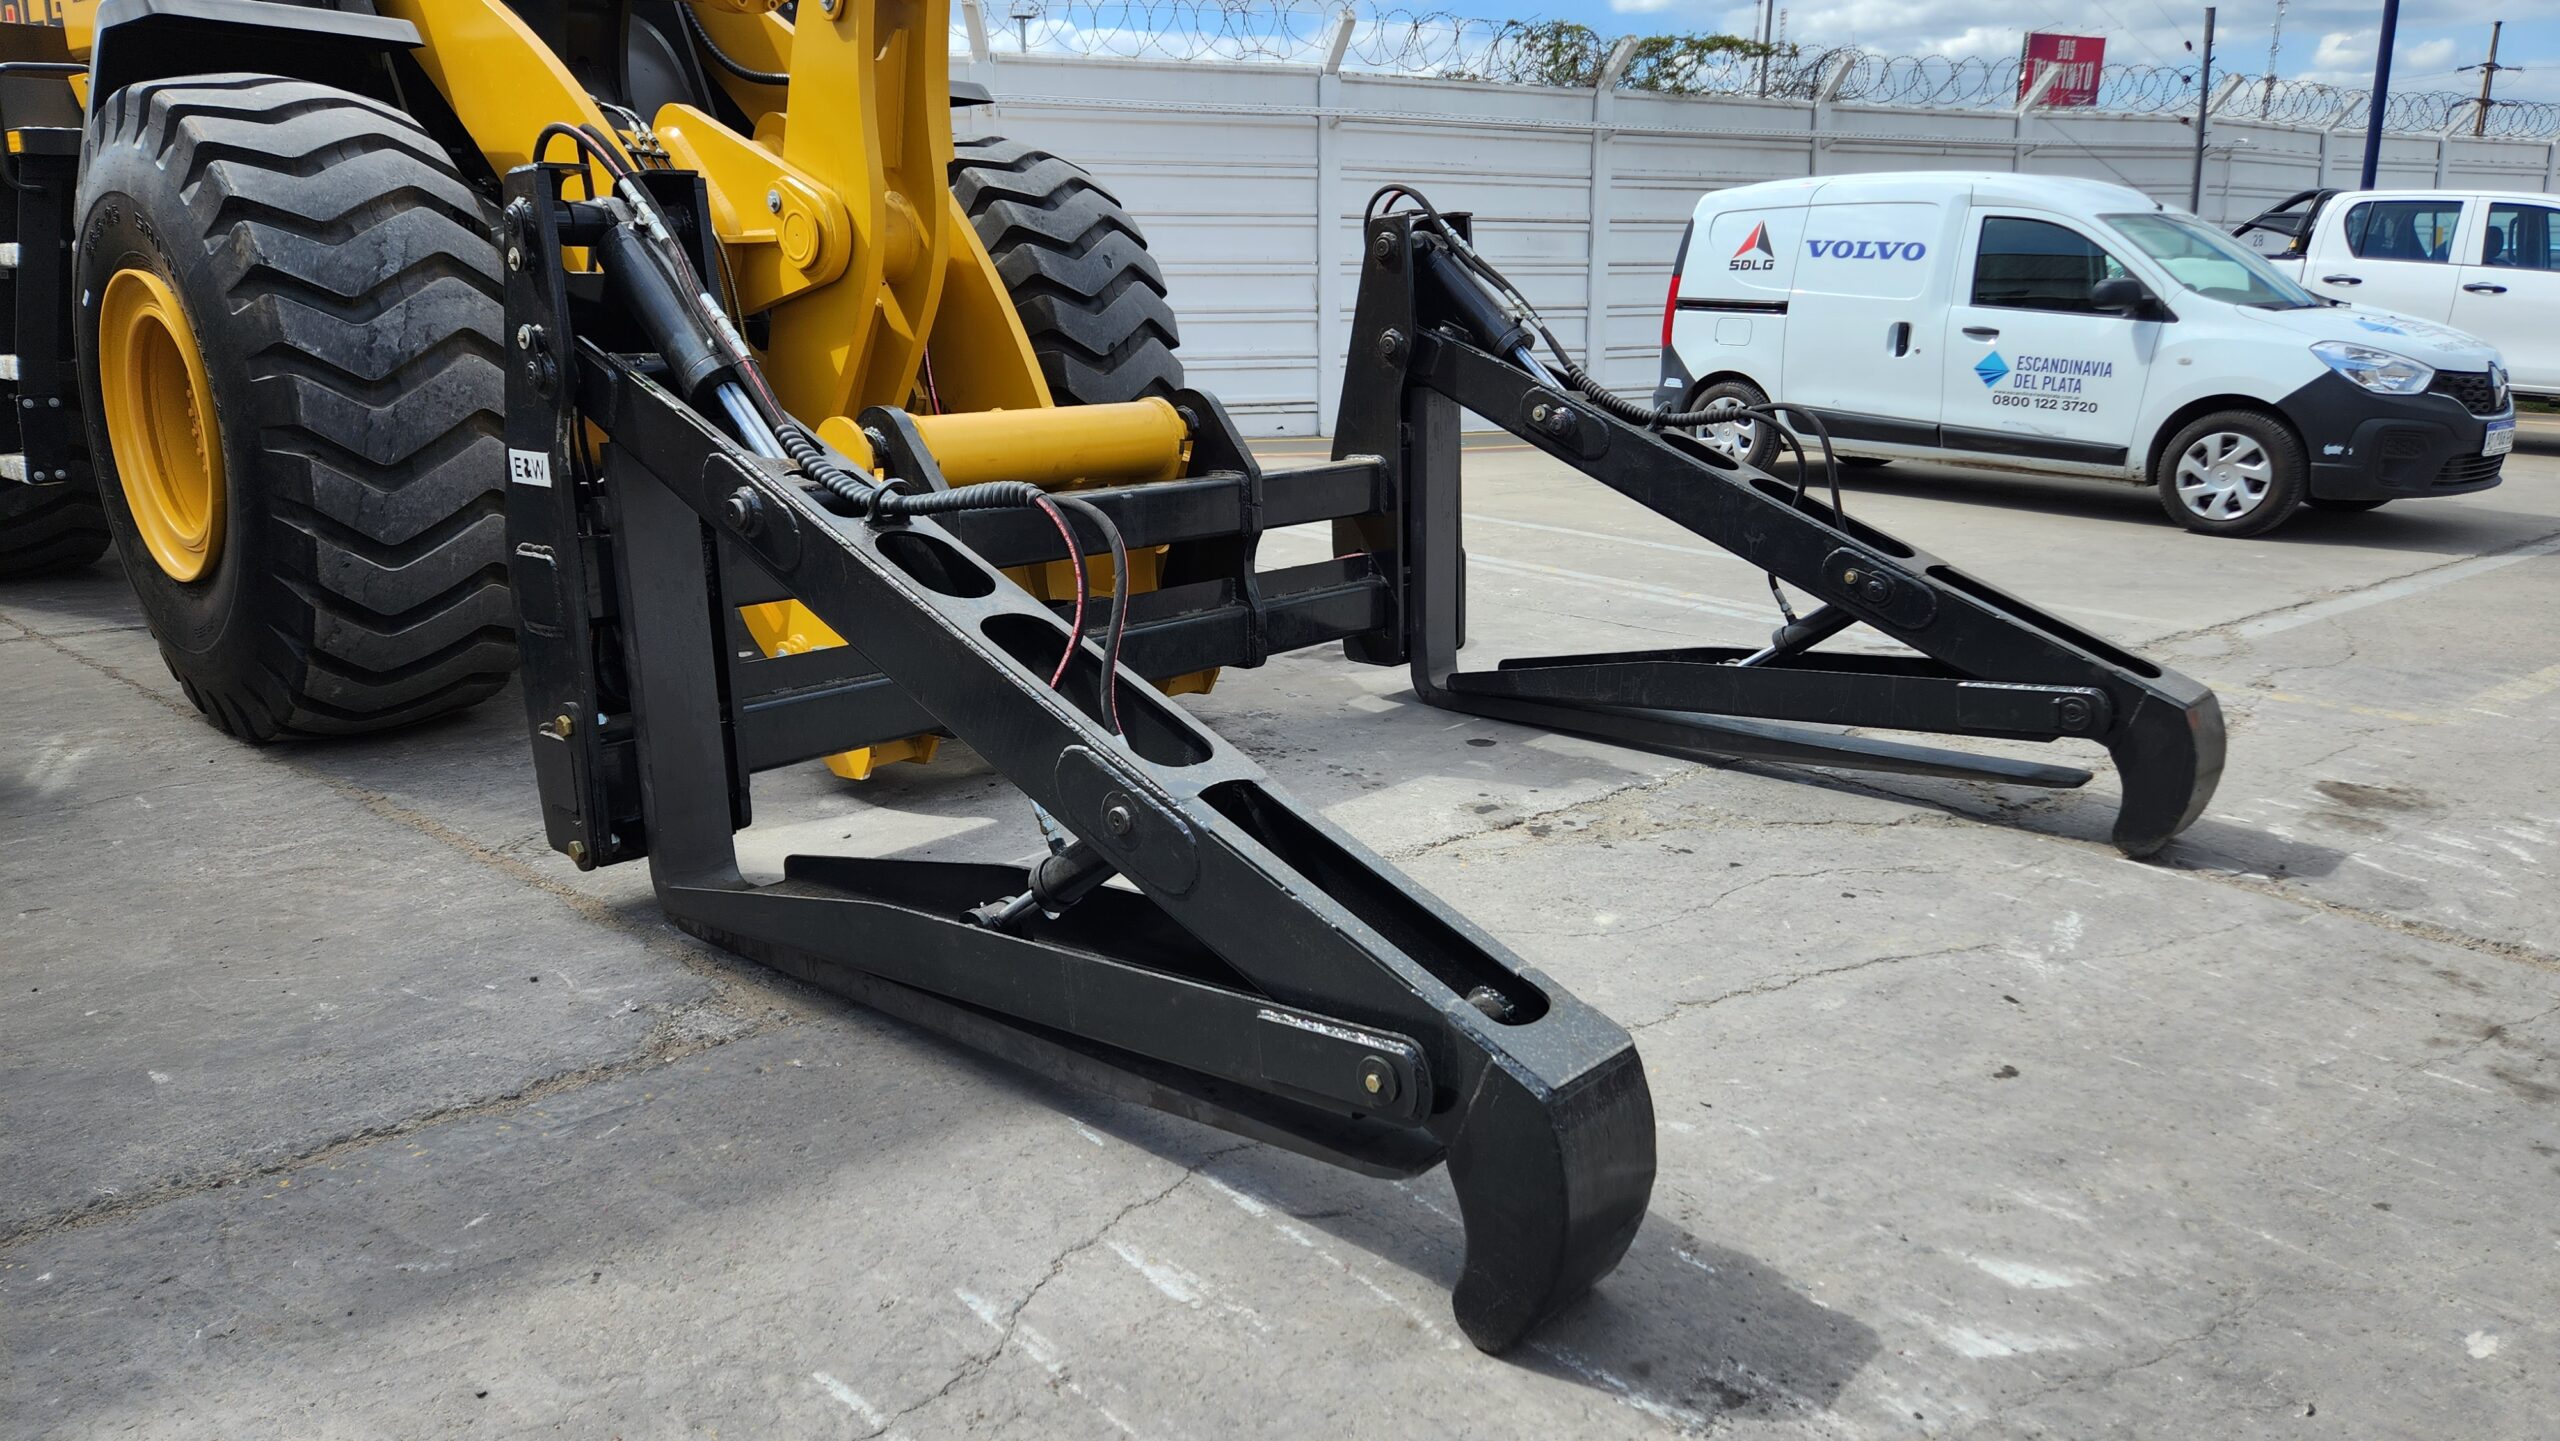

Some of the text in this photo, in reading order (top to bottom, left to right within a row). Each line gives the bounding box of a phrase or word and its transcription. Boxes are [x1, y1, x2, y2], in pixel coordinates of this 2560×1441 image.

[2057, 39, 2077, 60] SOS
[1806, 239, 1926, 261] VOLVO
[2253, 234, 2264, 247] 28
[1729, 259, 1775, 271] SDLG
[2016, 355, 2113, 378] ESCANDINAVIA
[2013, 373, 2082, 394] DEL PLATA
[1992, 394, 2098, 413] 0800 122 3720
[513, 456, 545, 481] E&W
